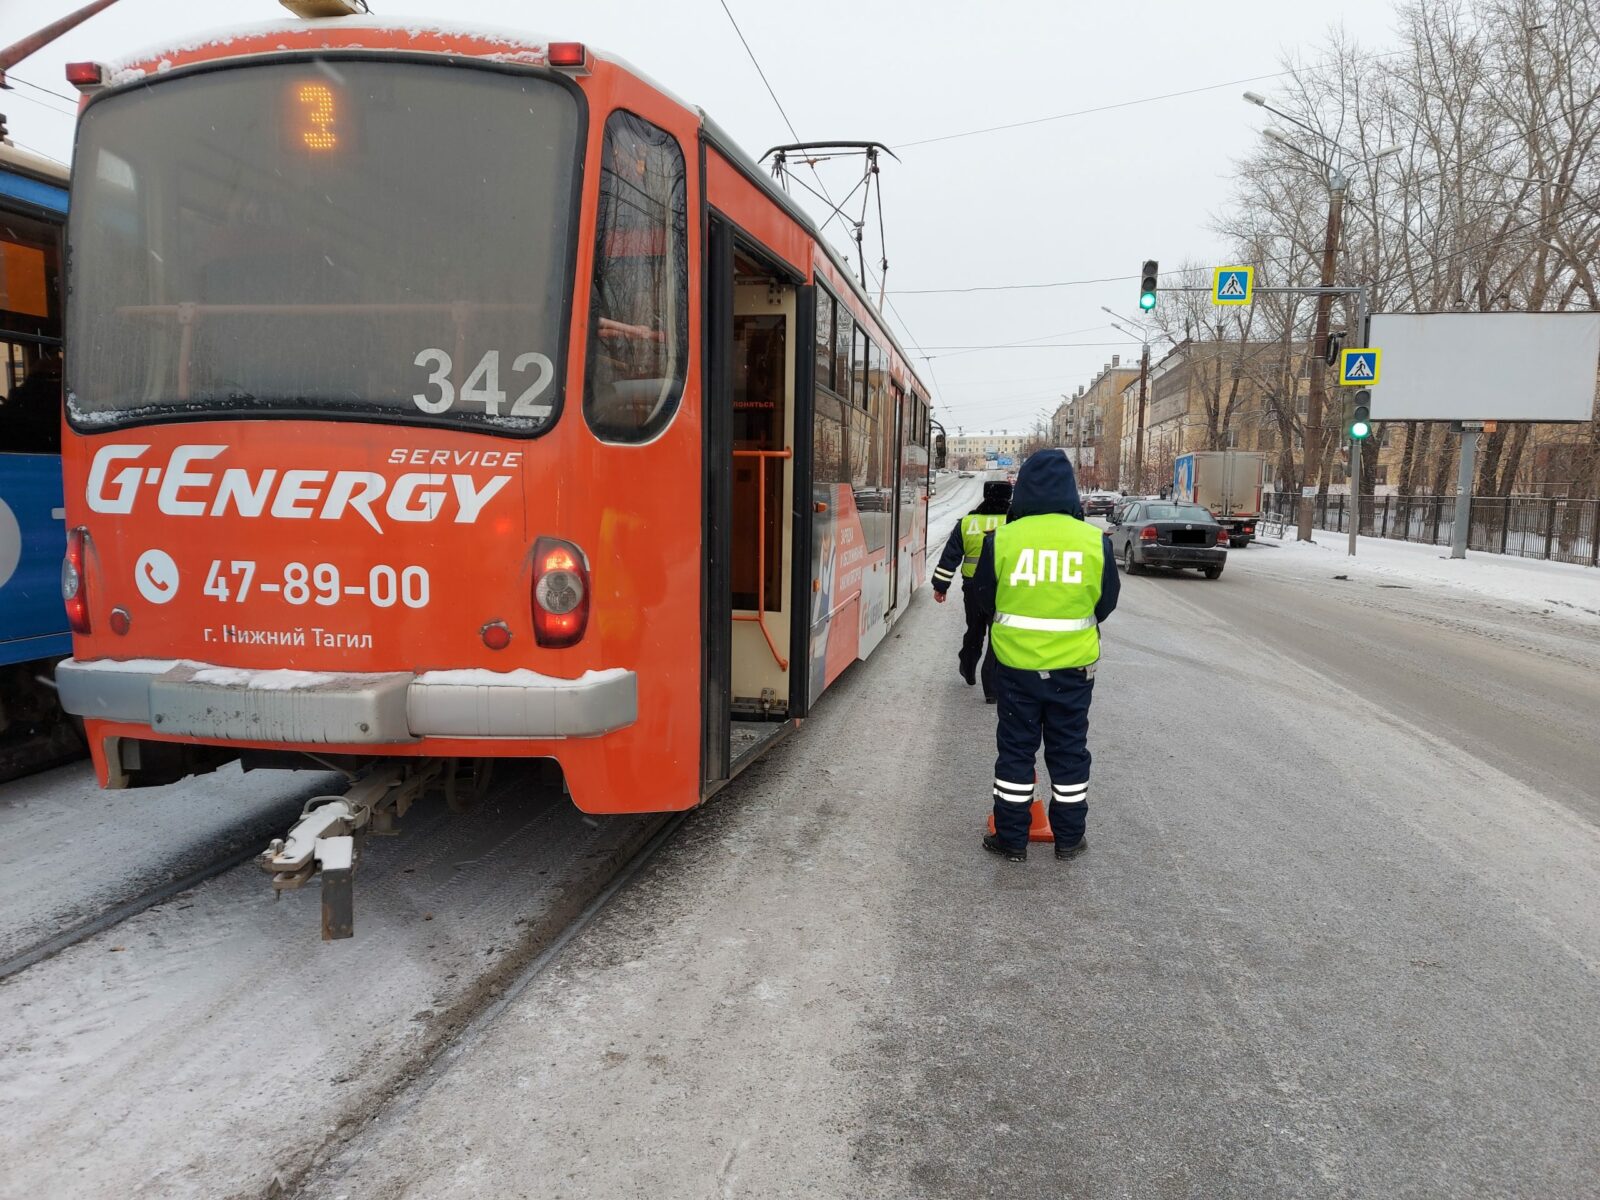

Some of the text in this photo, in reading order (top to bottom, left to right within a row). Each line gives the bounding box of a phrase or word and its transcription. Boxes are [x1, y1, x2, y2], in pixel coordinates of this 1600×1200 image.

[300, 86, 336, 148] 3
[412, 348, 554, 417] 342
[387, 448, 523, 467] SERVICE
[966, 516, 1007, 534] ДП
[203, 559, 430, 609] 47-89-00
[1010, 548, 1083, 587] ДПС
[203, 624, 373, 648] г. Нижний Тагил
